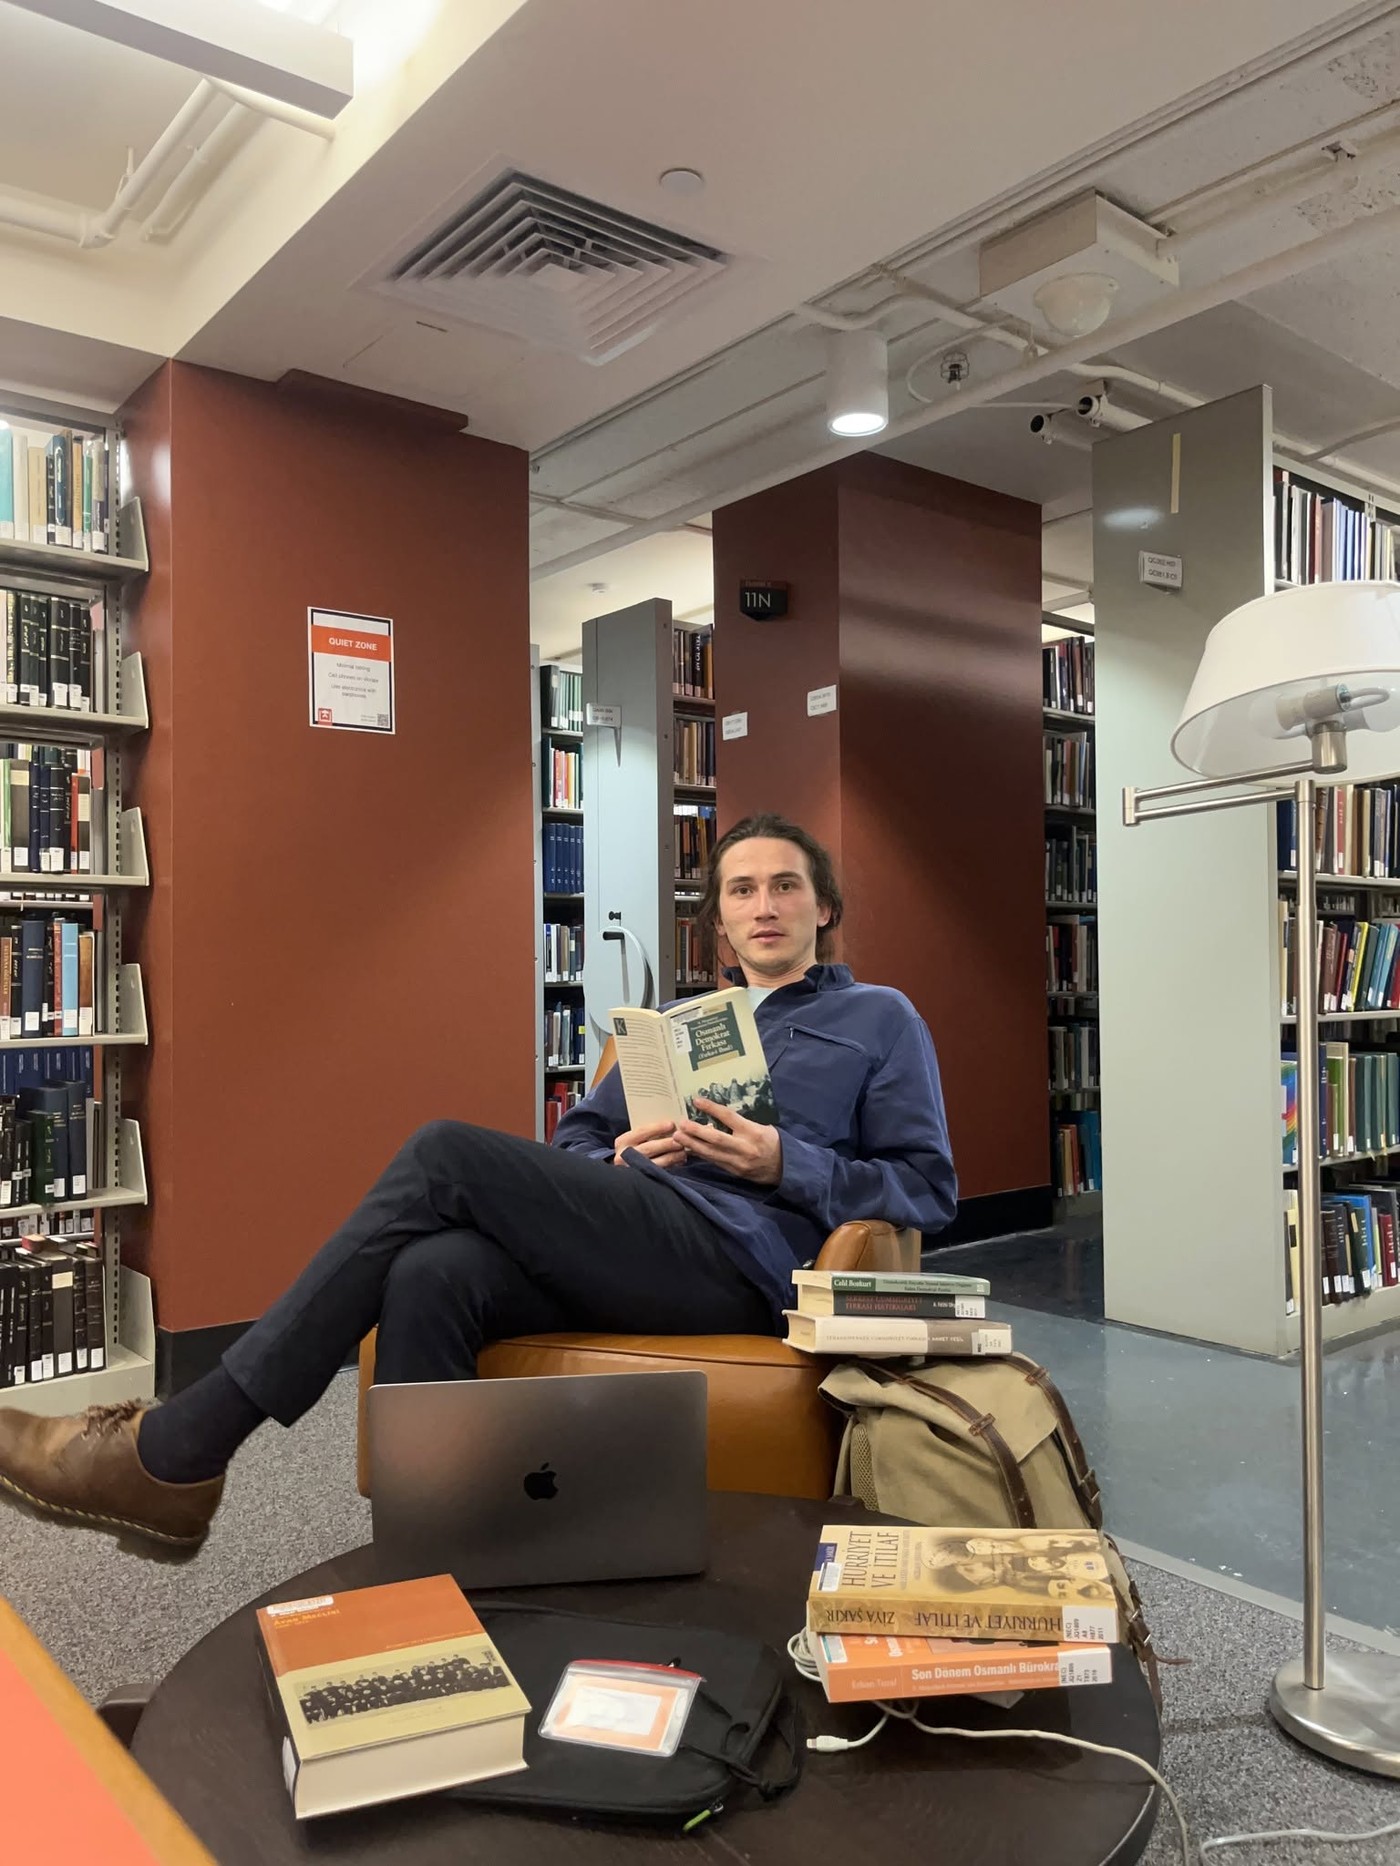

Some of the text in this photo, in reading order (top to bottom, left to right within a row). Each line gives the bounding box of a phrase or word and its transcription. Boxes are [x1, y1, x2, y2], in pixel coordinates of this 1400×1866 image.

[744, 591, 771, 608] 11N
[328, 637, 378, 651] QUIET ZONE
[695, 1022, 726, 1038] Osmanlı
[695, 1030, 731, 1046] Demokrat
[871, 1574, 896, 1588] VE
[867, 1610, 895, 1626] ZİYA
[964, 1614, 981, 1629] VE
[911, 1668, 932, 1681] Son
[935, 1666, 972, 1679] Dönem
[973, 1663, 1017, 1676] Osmanlı
